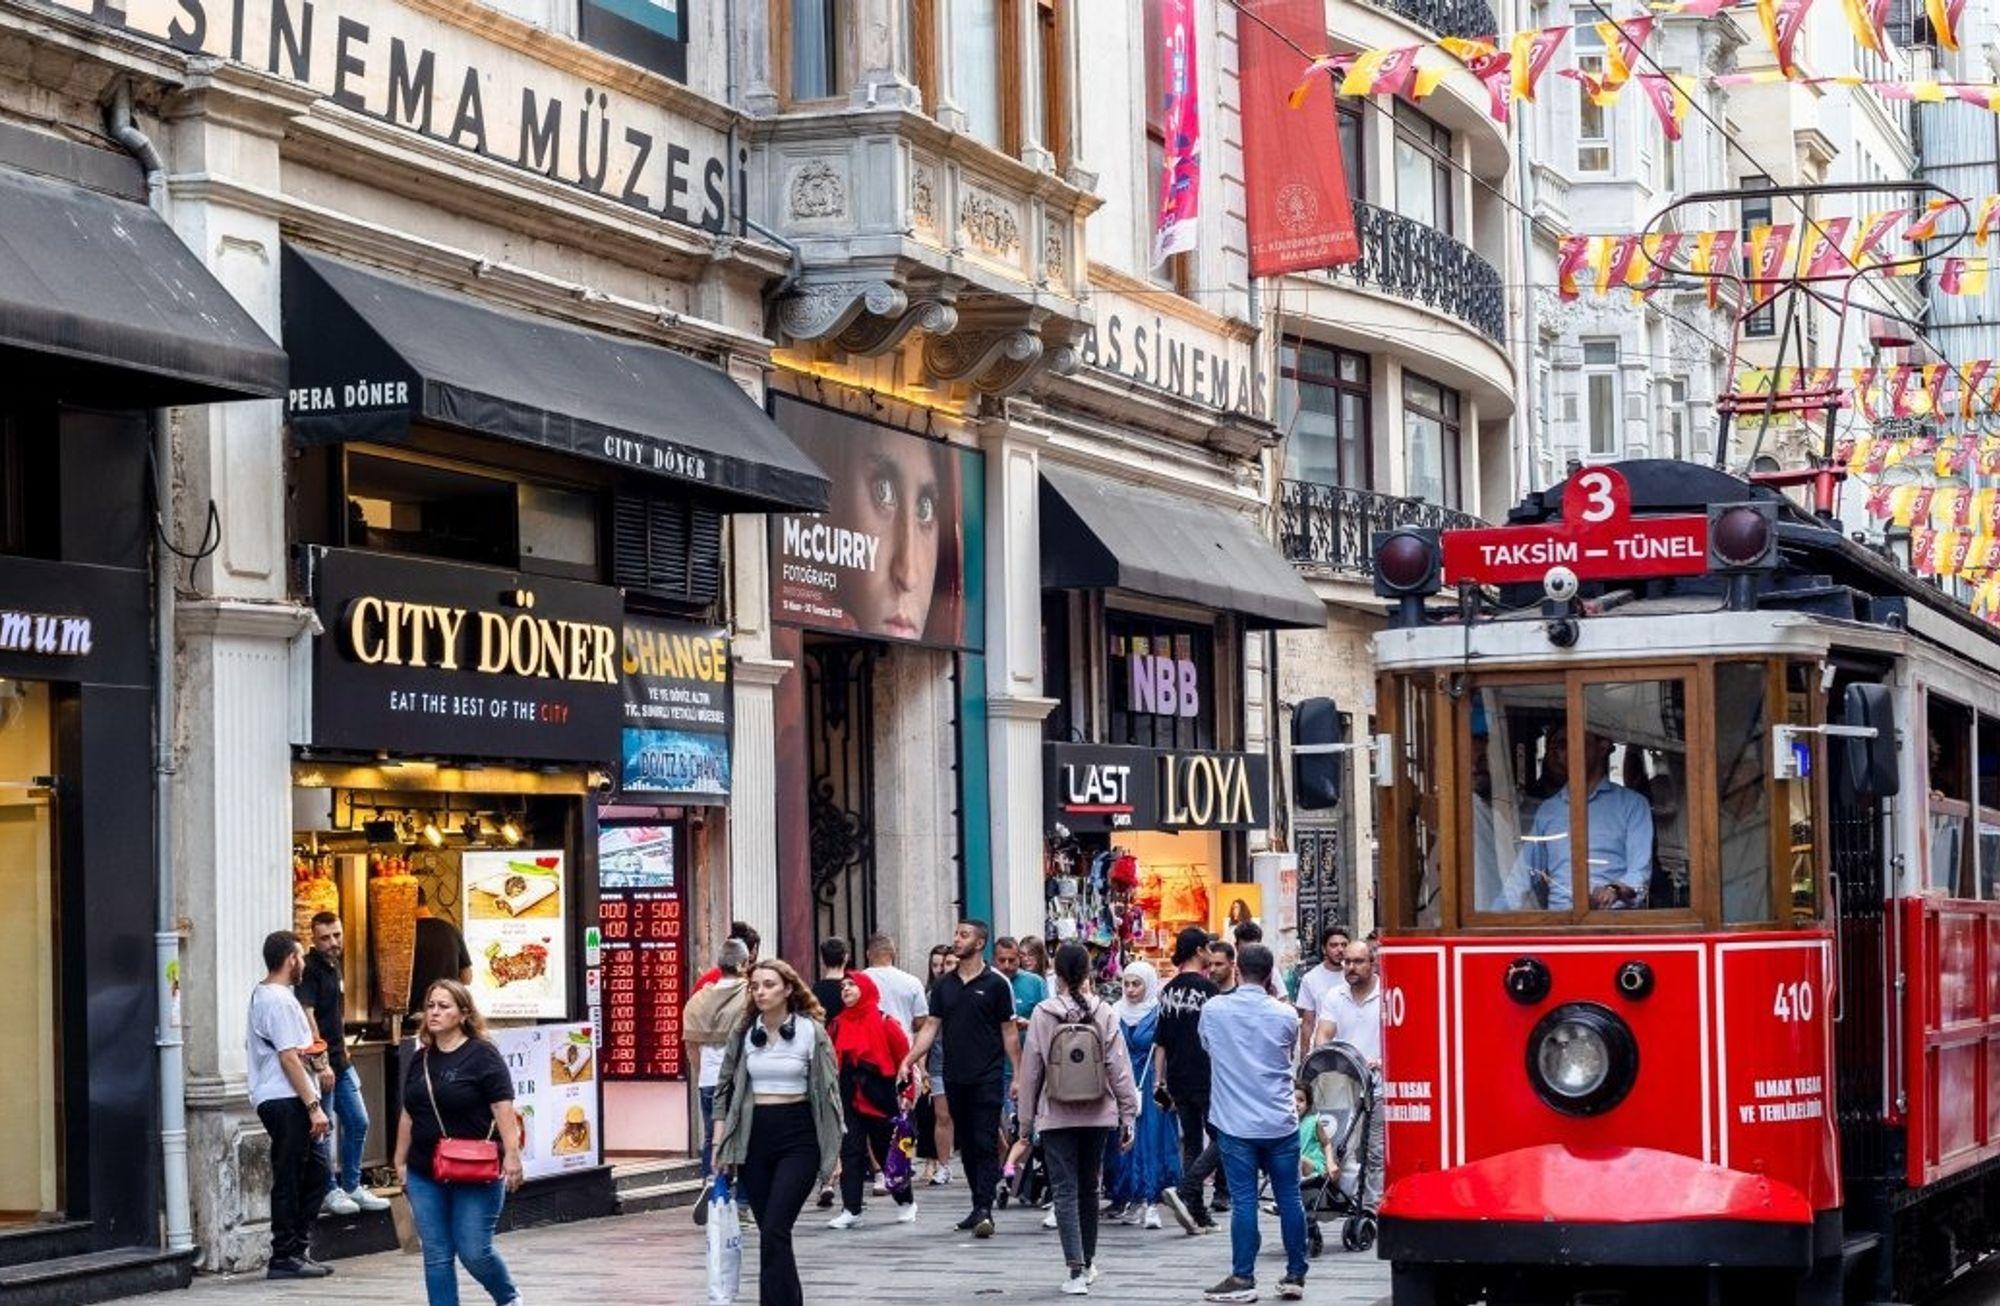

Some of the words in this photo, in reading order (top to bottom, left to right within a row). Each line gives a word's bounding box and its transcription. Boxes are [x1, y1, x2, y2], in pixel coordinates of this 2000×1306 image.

[518, 87, 748, 237] MÜZESİ
[289, 387, 336, 411] PERA
[344, 379, 409, 408] DÖNER
[604, 435, 643, 464] CITY
[653, 446, 706, 479] DÖNER
[1578, 472, 1616, 522] 3
[782, 515, 880, 572] McCURRY
[1479, 537, 1579, 566] TAKSİM
[1613, 534, 1704, 560] TÜNEL
[351, 595, 467, 671] CITY
[476, 588, 619, 685] DÖNER
[623, 626, 727, 684] CHANGE
[390, 690, 415, 711] EAT
[422, 693, 447, 714] THE
[453, 696, 485, 717] BEST
[490, 699, 507, 718] OF
[512, 701, 535, 721] THE
[540, 703, 568, 724] CITY
[1131, 653, 1200, 718] NBB
[1068, 763, 1131, 804] LAST
[1164, 754, 1257, 827] LOYA
[1773, 980, 1814, 1024] 410
[1739, 1105, 1757, 1124] VE
